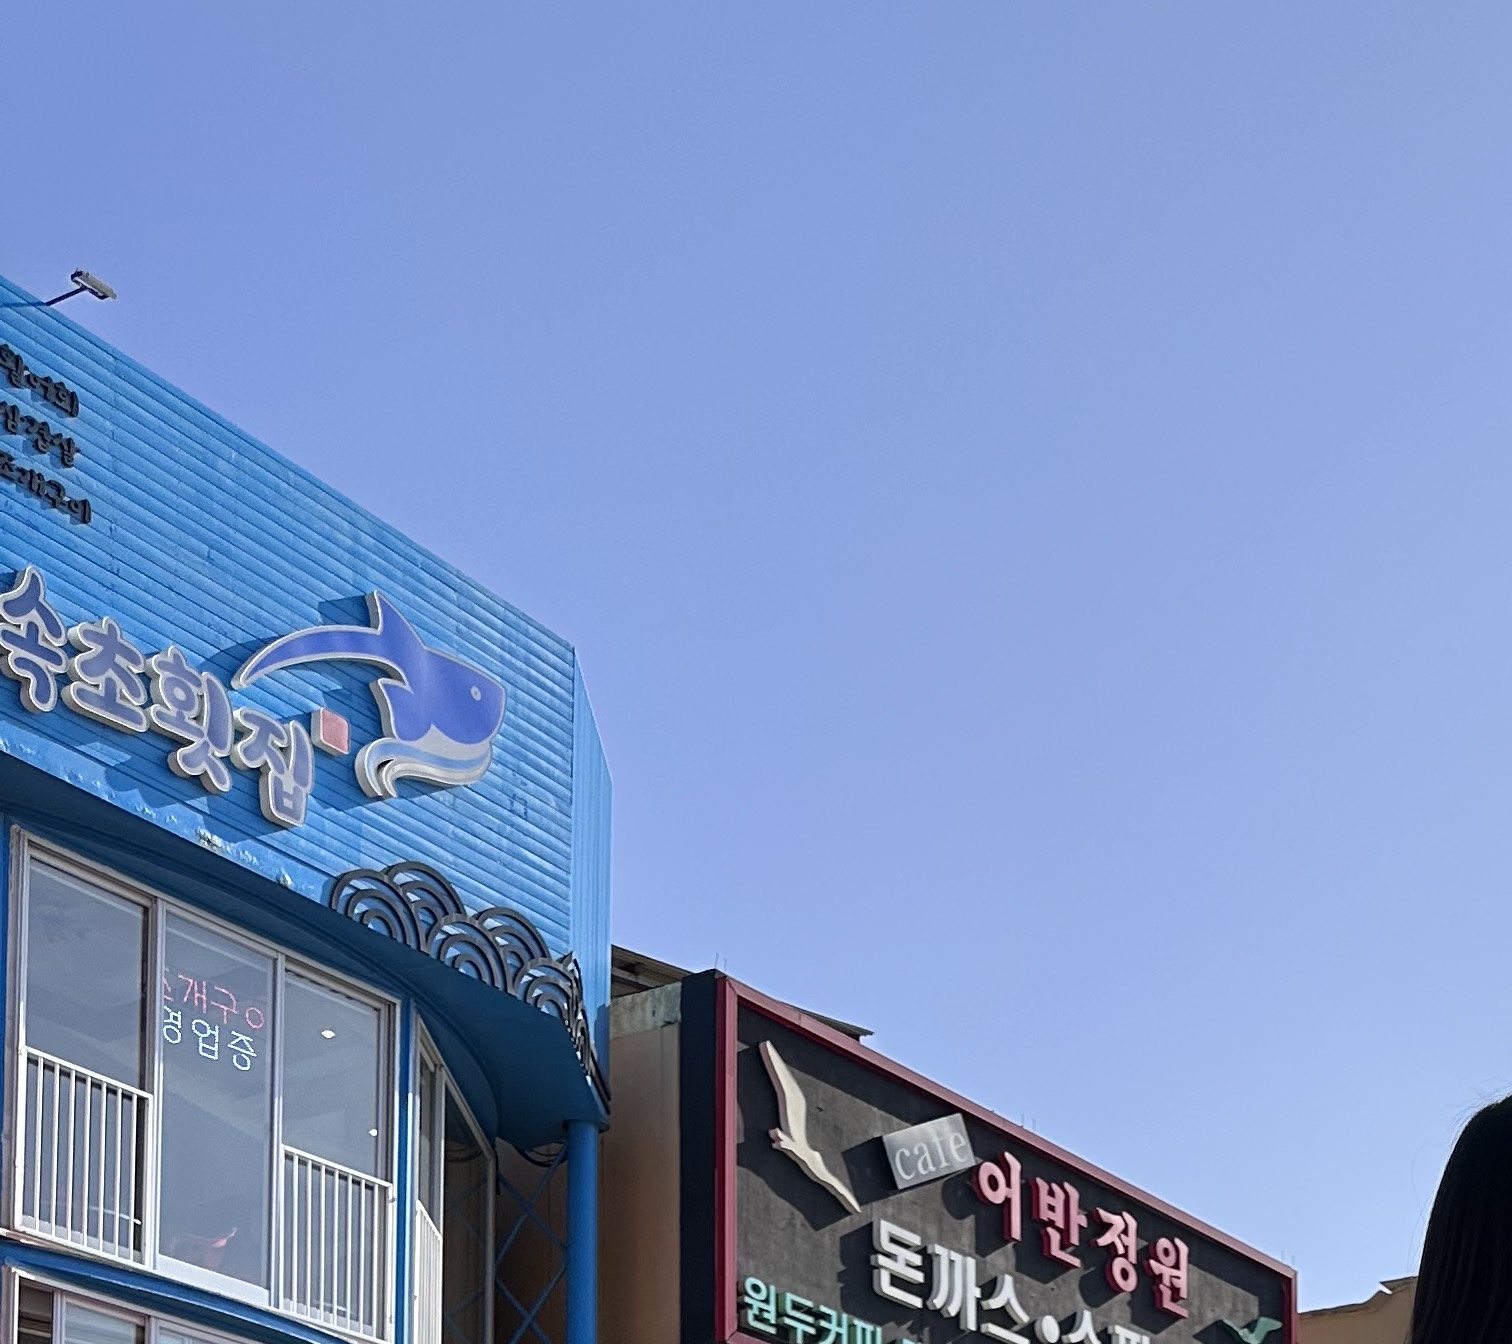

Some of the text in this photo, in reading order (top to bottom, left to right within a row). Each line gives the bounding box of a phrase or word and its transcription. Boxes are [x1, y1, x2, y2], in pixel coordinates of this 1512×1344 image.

[0, 565, 316, 827] 속초횟집
[894, 1124, 970, 1182] cafe
[973, 1150, 1190, 1318] 어반정원
